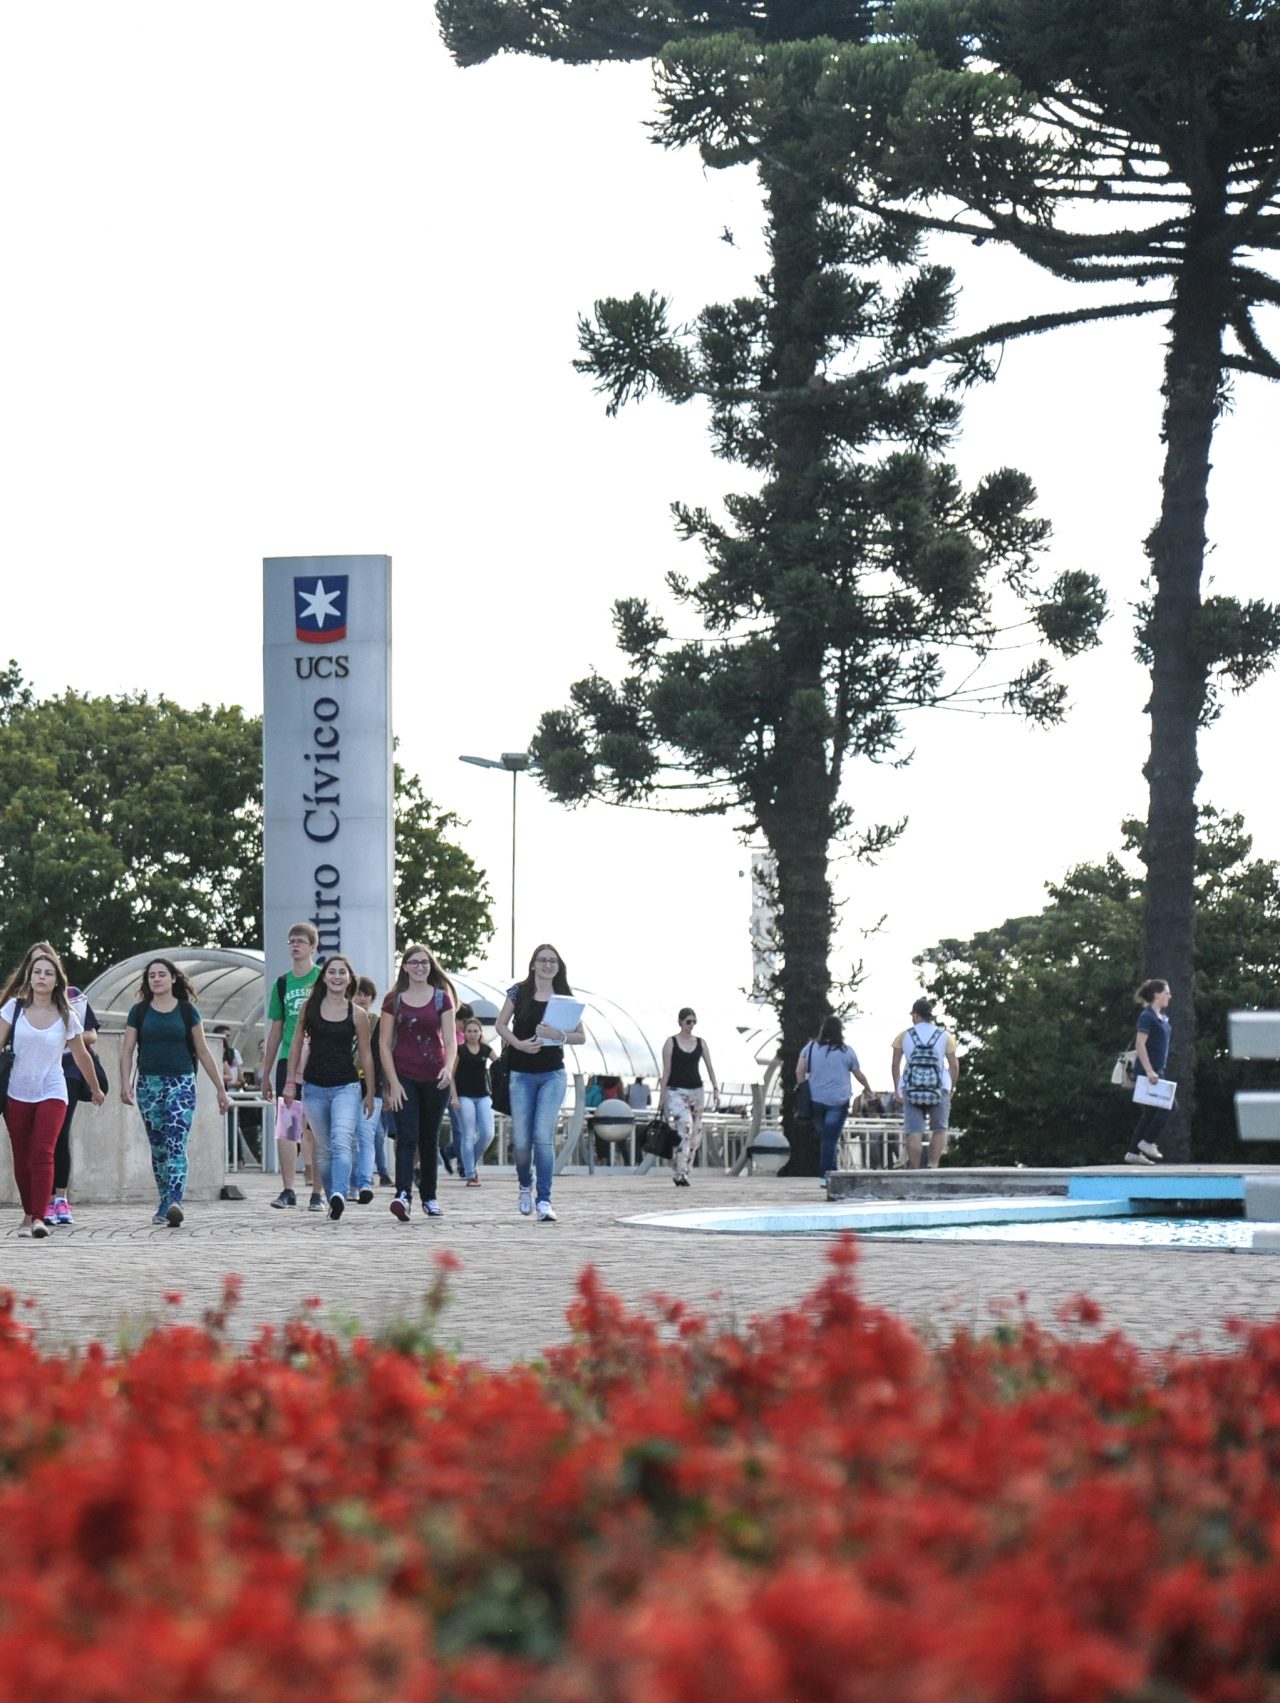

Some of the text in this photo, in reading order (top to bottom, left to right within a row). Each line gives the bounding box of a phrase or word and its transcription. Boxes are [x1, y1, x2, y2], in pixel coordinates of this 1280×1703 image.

[294, 655, 350, 680] UCS
[303, 696, 341, 967] ntro Cívico
